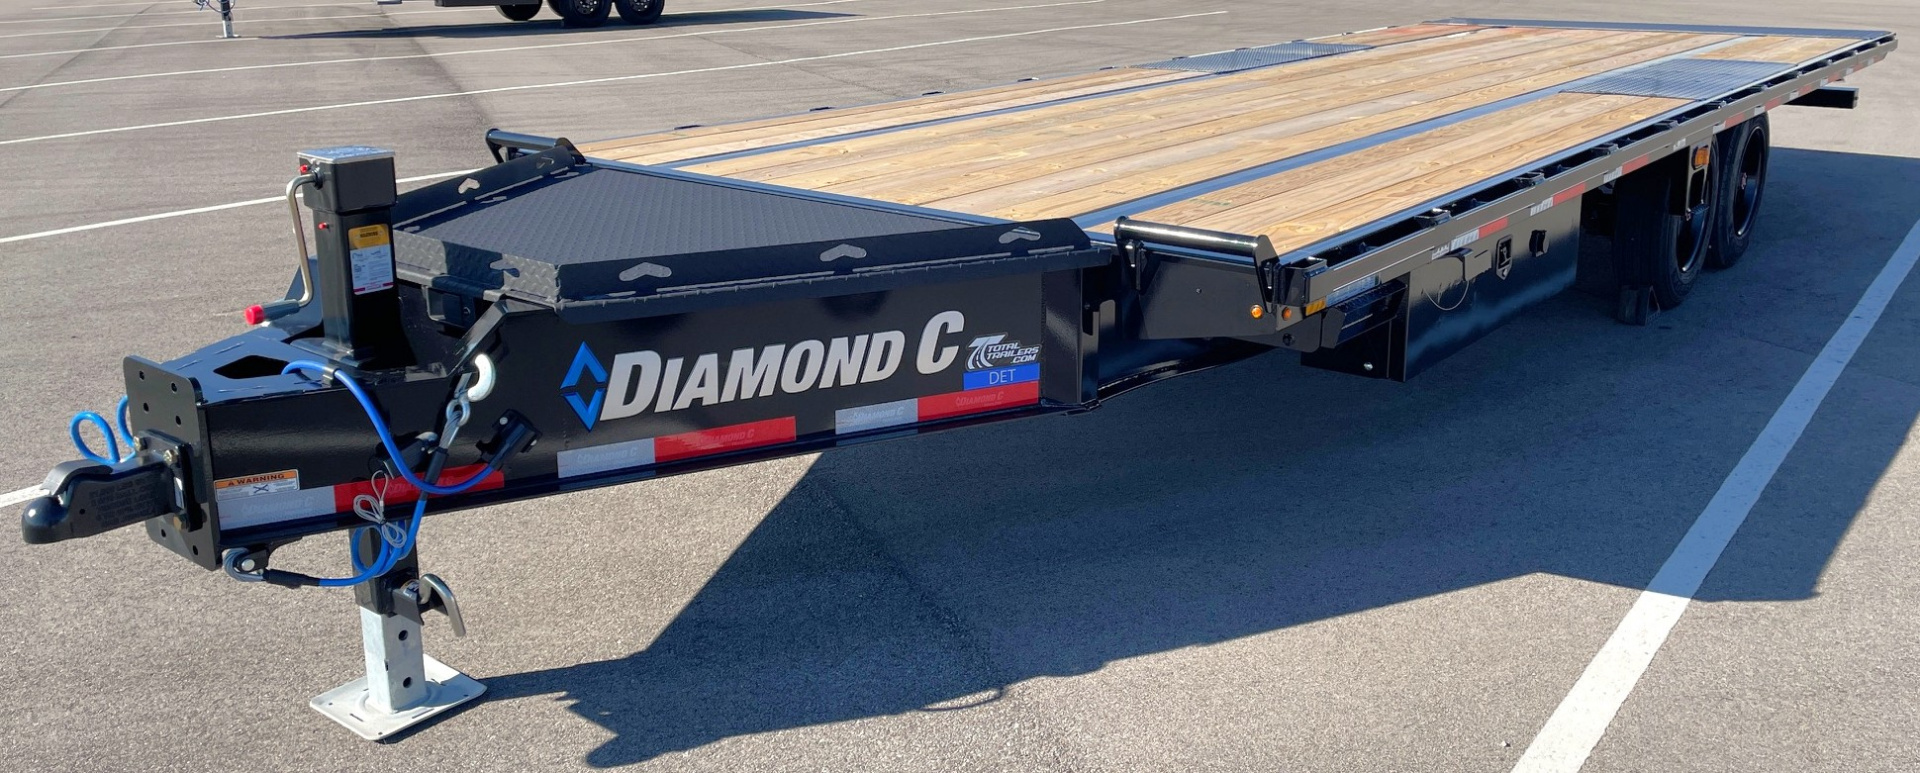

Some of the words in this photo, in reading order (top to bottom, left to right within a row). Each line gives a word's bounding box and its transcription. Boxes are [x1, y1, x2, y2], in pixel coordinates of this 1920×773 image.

[987, 346, 1040, 360] TRAILERS
[988, 342, 1020, 353] TOTAL
[1010, 354, 1037, 364] .COM
[600, 329, 905, 422] DIAMOND
[916, 310, 965, 375] C
[989, 368, 1017, 385] DET
[960, 394, 997, 406] DIAMOND
[997, 391, 1005, 401] C
[897, 406, 905, 416] C
[747, 428, 755, 439] C
[630, 446, 638, 457] C
[238, 472, 285, 485] WARNING
